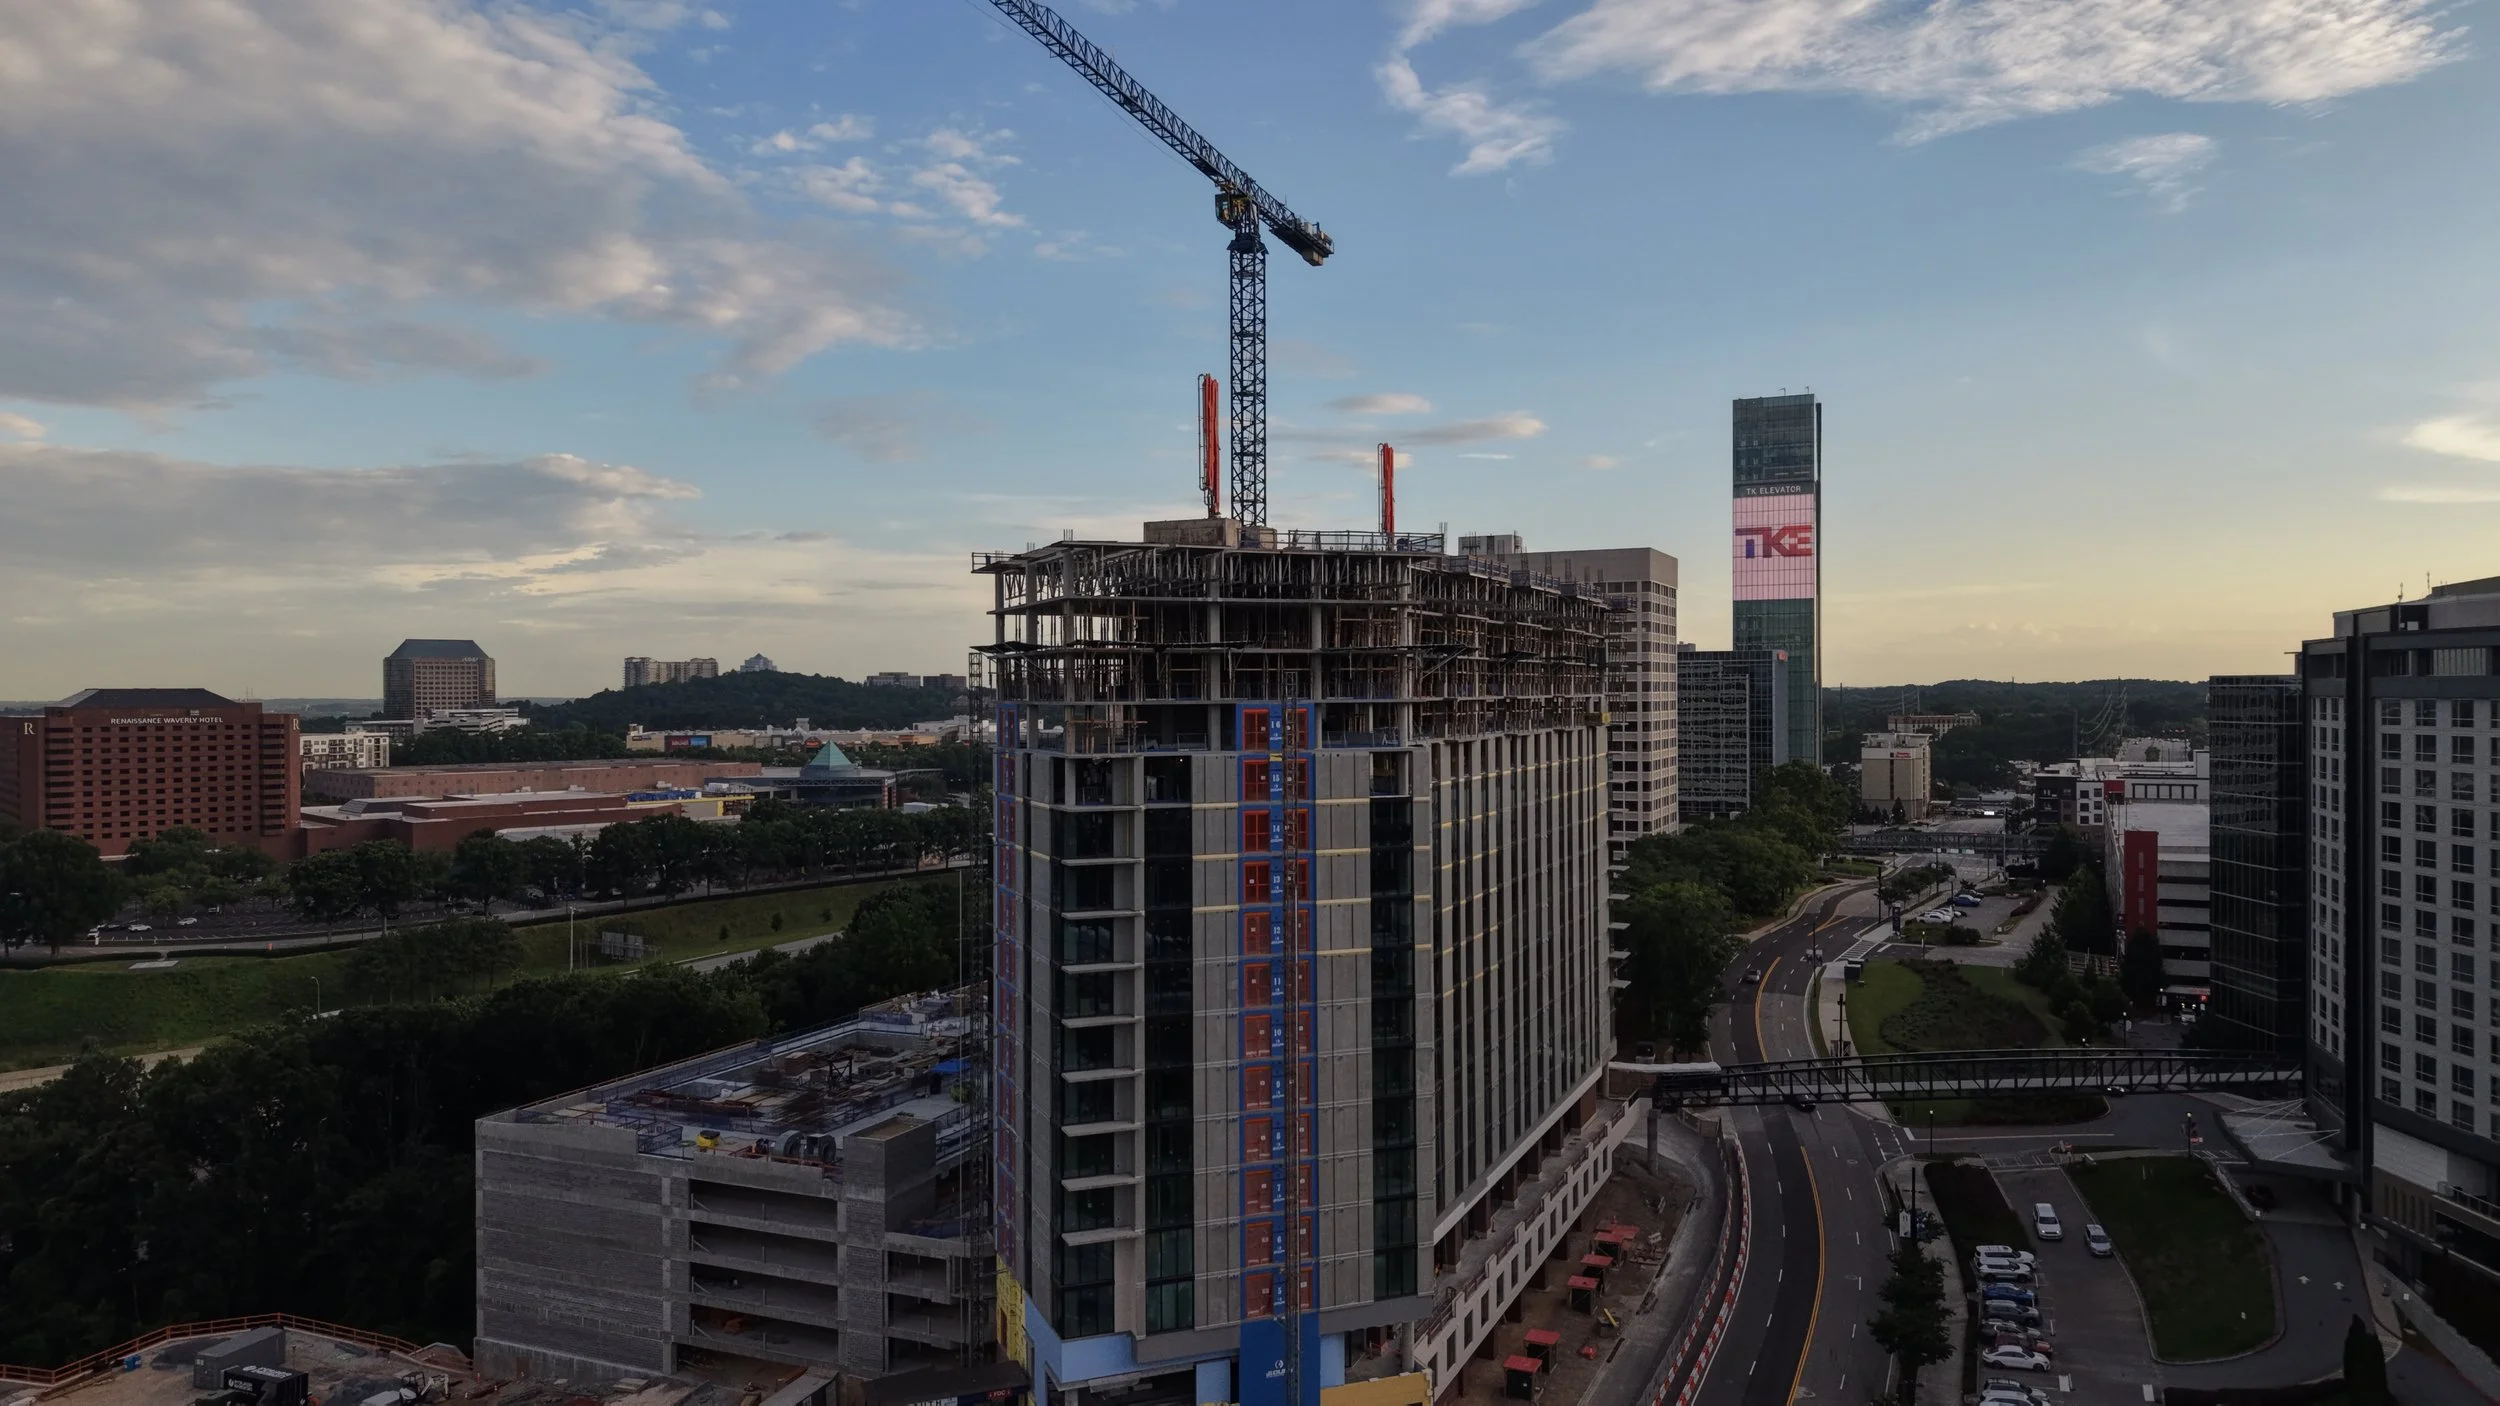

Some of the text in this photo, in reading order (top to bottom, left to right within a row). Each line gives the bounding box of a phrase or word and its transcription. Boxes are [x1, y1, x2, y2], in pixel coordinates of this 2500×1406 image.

[1759, 486, 1801, 494] ELEVATOR
[1735, 525, 1812, 558] TKE
[110, 717, 161, 725] RENAISSANCE
[292, 718, 300, 731] R
[1271, 720, 1281, 729] 16
[24, 722, 36, 735] R
[1272, 774, 1280, 782] 15
[1272, 824, 1280, 833] 14
[1273, 926, 1281, 934] 12
[1273, 977, 1281, 985] 11
